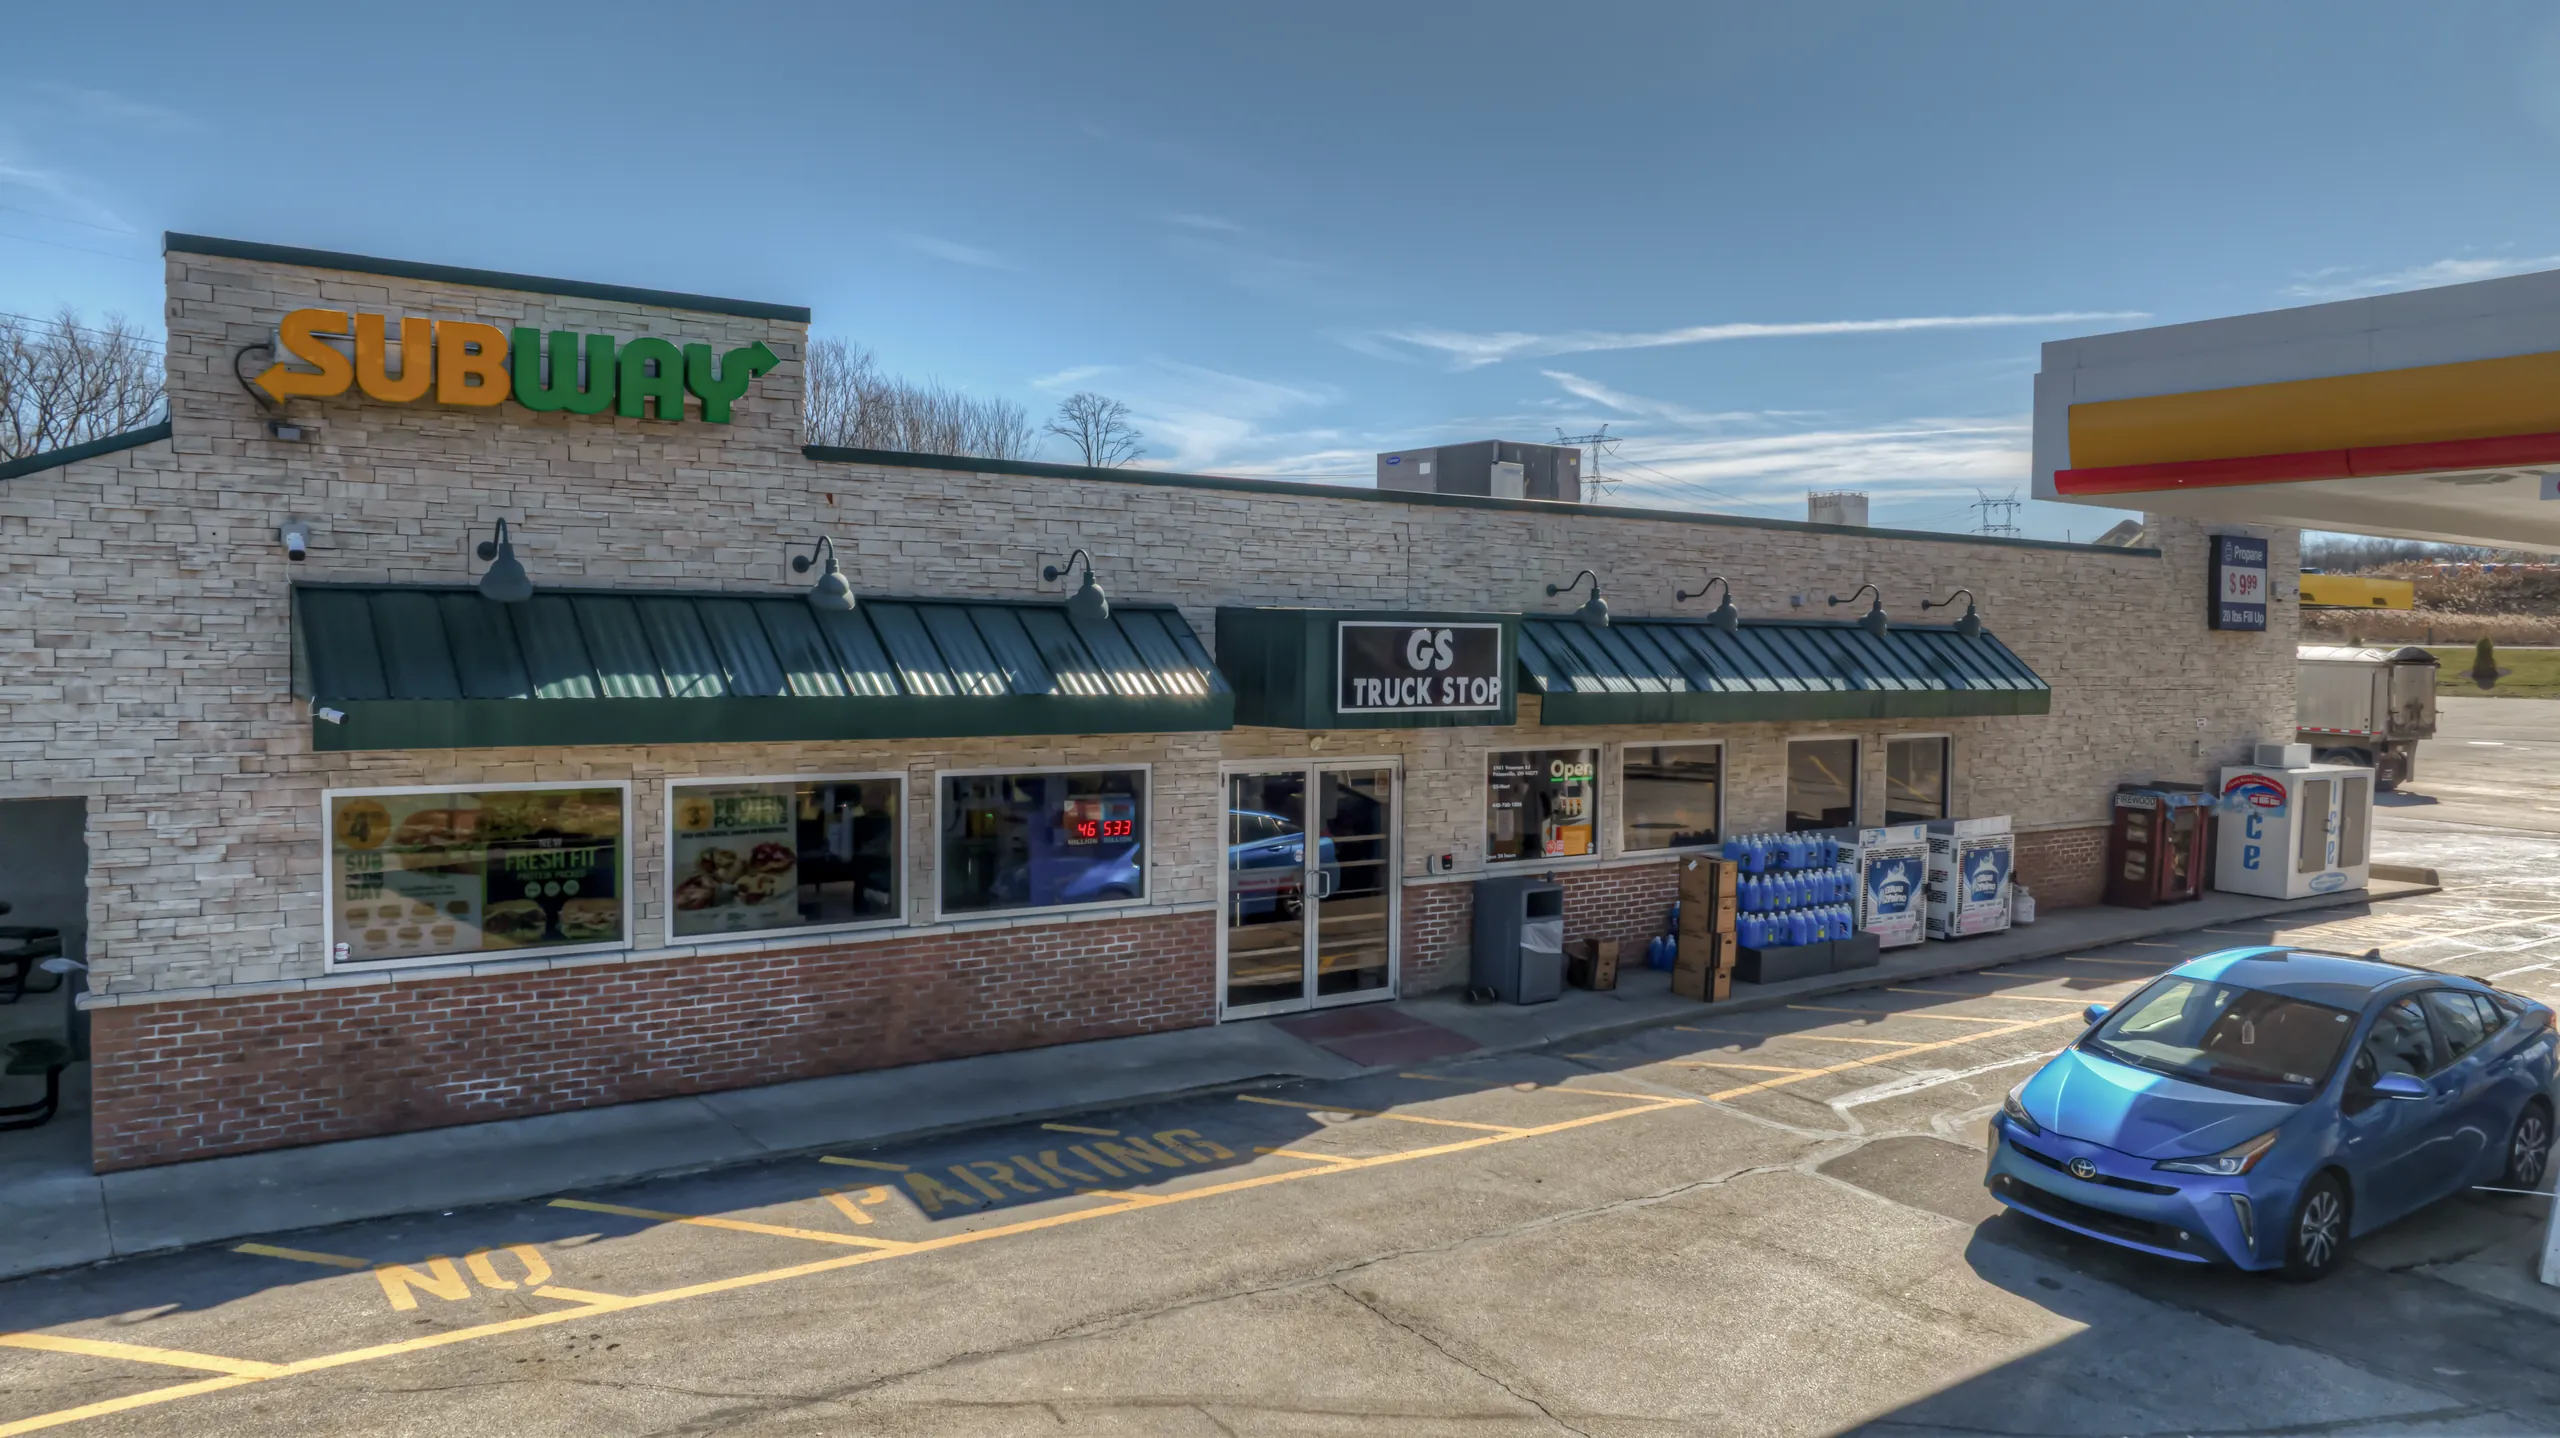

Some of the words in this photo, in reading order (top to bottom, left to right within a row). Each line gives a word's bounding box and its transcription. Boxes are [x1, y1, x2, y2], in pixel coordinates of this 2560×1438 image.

[254, 308, 781, 424] SUBWAY
[2234, 545, 2262, 563] Propane
[2222, 609, 2231, 622] 20
[2231, 609, 2242, 623] lbs
[2243, 610, 2253, 623] Fill
[2254, 611, 2264, 626] Up
[1407, 628, 1454, 671] GS
[1353, 676, 1433, 706] TRUCK
[1442, 676, 1502, 705] STOP
[1550, 759, 1593, 780] Open
[2115, 795, 2156, 806] FIREWOOD
[1077, 821, 1096, 837] 46
[1103, 820, 1131, 836] 533
[539, 838, 562, 848] NEW
[1067, 838, 1098, 846] MILLION
[345, 852, 384, 871] SUB
[505, 850, 565, 872] FRESH
[570, 848, 596, 868] FIT
[345, 882, 384, 901] DAY
[820, 1129, 1237, 1225] PARKING
[374, 1241, 554, 1311] NO
